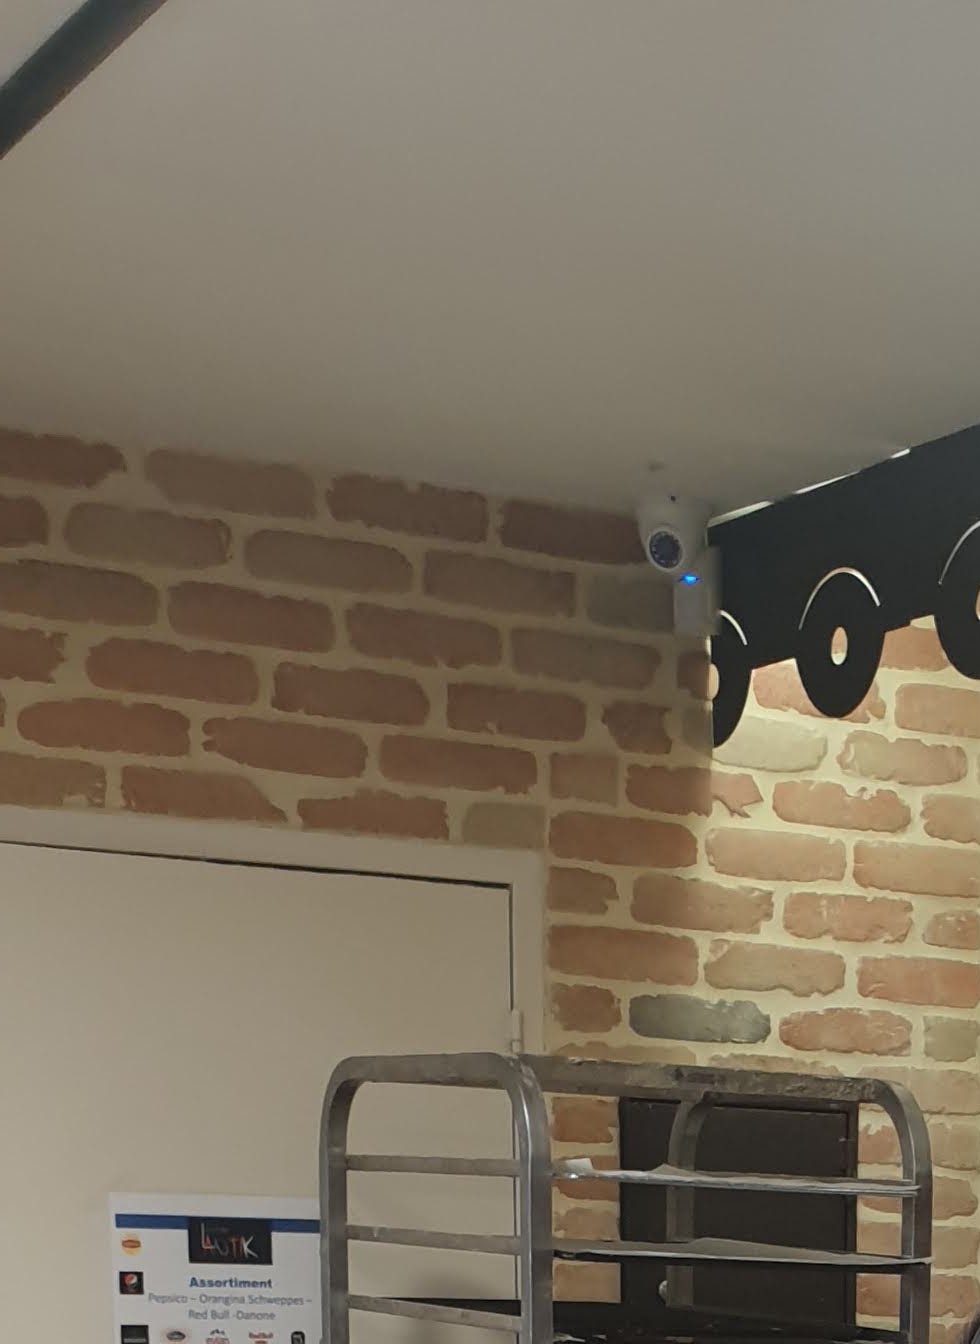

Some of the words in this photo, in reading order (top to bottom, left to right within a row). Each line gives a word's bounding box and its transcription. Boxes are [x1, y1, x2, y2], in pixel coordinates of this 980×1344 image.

[189, 1277, 273, 1288] Assortiment
[149, 1293, 188, 1305] Pepsico
[199, 1294, 246, 1306] Orangina
[249, 1295, 304, 1307] Schweppes
[188, 1310, 208, 1320] Red
[210, 1311, 230, 1320] Bull
